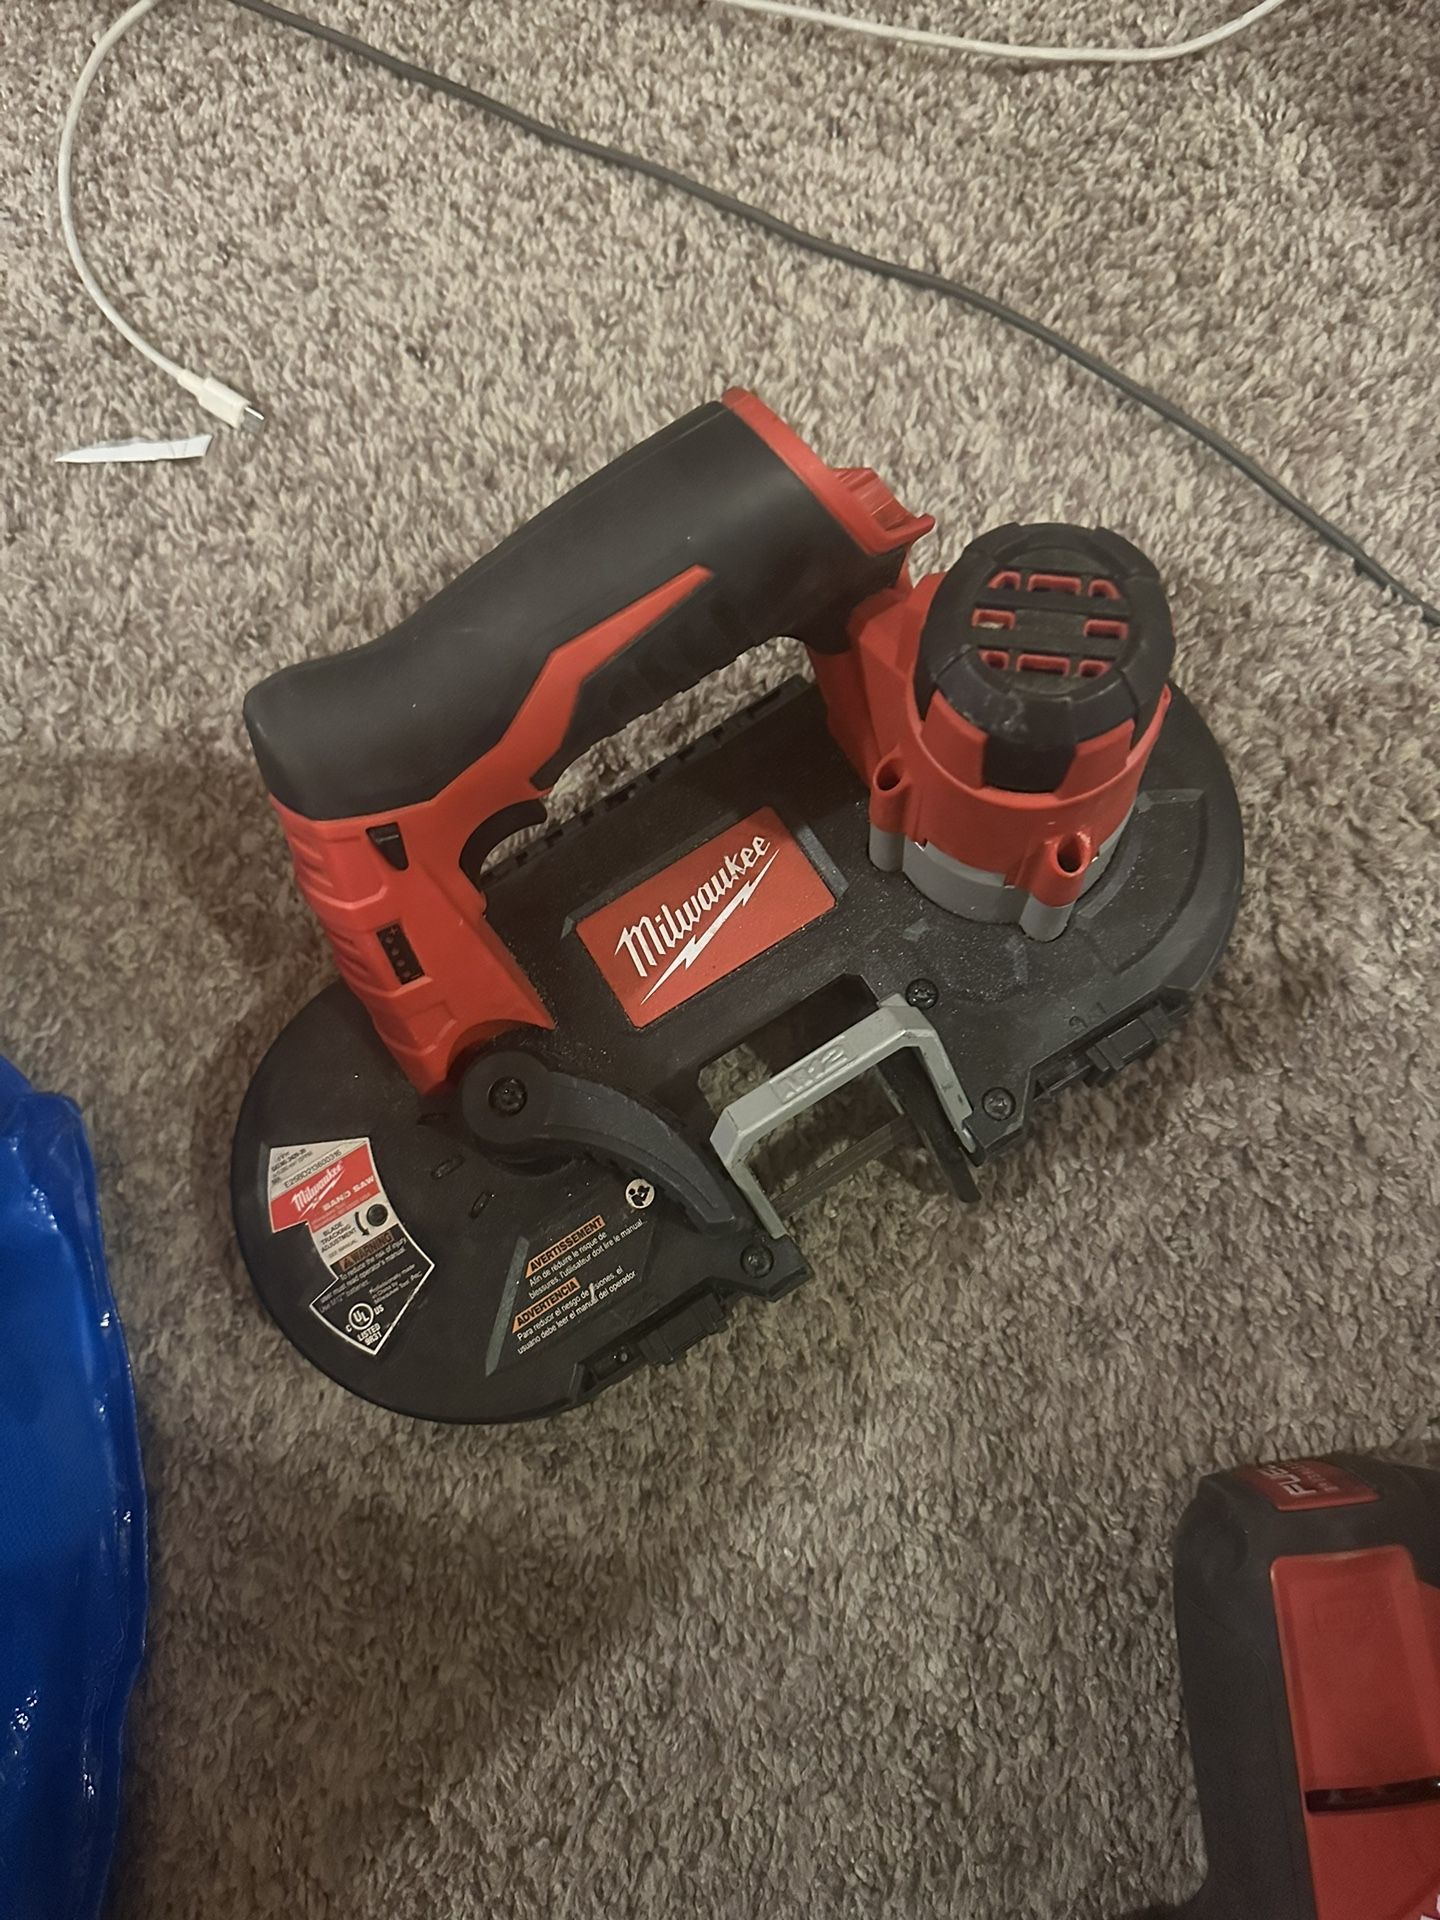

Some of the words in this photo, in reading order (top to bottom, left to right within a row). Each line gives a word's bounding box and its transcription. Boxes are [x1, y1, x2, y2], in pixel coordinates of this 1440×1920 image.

[614, 835, 771, 977] Milwaukee
[291, 1163, 342, 1213] Milwaukee
[323, 1190, 352, 1211] BAND
[353, 1176, 375, 1192] SAW
[320, 1228, 357, 1252] ADJUSTMENT
[321, 1224, 351, 1244] TRACKING
[323, 1222, 343, 1236] BLADE
[530, 1216, 602, 1271] AVERTISSEMENT
[347, 1262, 365, 1276] reduce
[366, 1256, 374, 1264] the
[375, 1250, 385, 1258] risk
[351, 1233, 392, 1262] WARNING
[529, 1275, 542, 1286] Afin
[542, 1269, 551, 1278] de
[579, 1237, 599, 1254] risque
[598, 1231, 607, 1240] de
[529, 1276, 560, 1299] blessures,
[560, 1254, 592, 1278] l'utilisateur
[592, 1246, 604, 1257] doit
[603, 1239, 614, 1249] lire
[613, 1234, 620, 1242] le
[332, 1284, 346, 1295] must
[515, 1281, 578, 1326] ADVERTENCIA
[517, 1327, 533, 1341] Para
[533, 1313, 555, 1331] reducir
[554, 1308, 561, 1316] el
[561, 1296, 582, 1313] riesgo
[580, 1290, 589, 1299] de
[616, 1267, 623, 1275] el
[353, 1308, 369, 1325] UL
[357, 1323, 381, 1341] LISTED
[518, 1335, 541, 1354] usuario
[540, 1324, 556, 1338] debe
[556, 1316, 569, 1327] leer
[569, 1311, 576, 1319] el
[598, 1289, 609, 1299] del
